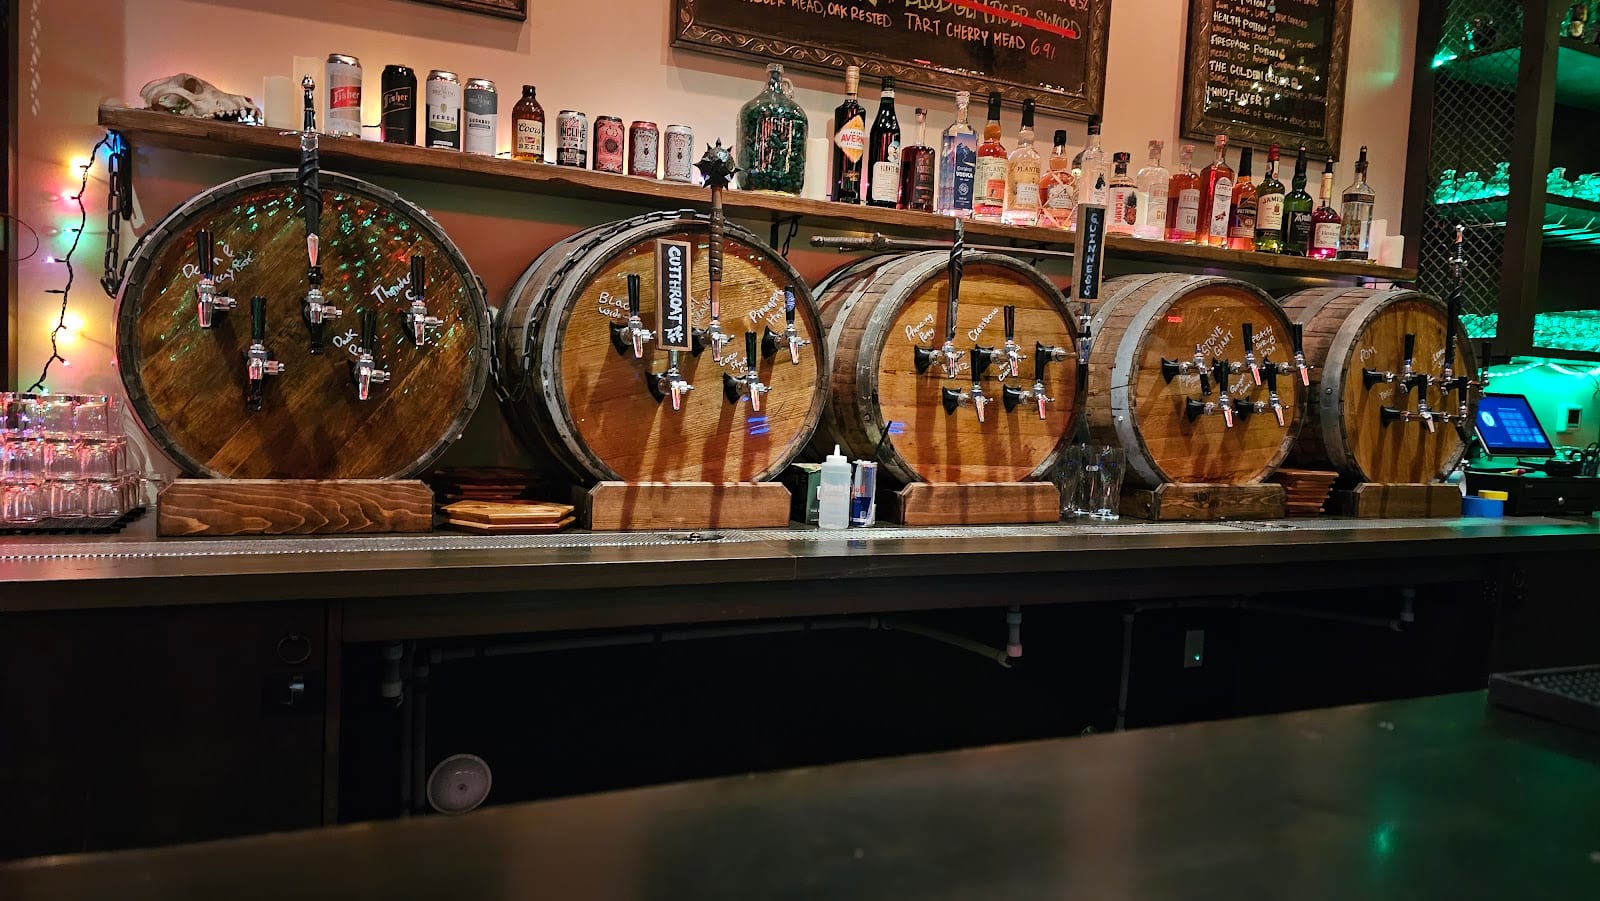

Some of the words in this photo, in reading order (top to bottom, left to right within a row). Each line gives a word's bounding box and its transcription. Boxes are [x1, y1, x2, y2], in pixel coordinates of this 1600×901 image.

[827, 2, 848, 19] OAK
[850, 6, 892, 28] RESTED
[1213, 11, 1241, 27] HEALTH
[1242, 19, 1267, 33] POTION
[904, 12, 941, 36] TART
[946, 22, 989, 47] CHERRY
[993, 31, 1026, 50] MEAD
[1210, 34, 1250, 51] FIRESPARK
[1253, 44, 1279, 58] POTION
[1209, 60, 1227, 73] THE
[1230, 64, 1264, 80] GOLDEN
[334, 88, 360, 104] Fisher
[518, 122, 541, 134] Coors
[1083, 213, 1099, 296] GUINNESS
[667, 245, 683, 325] CUTTHROAT
[919, 327, 935, 342] Pony
[1202, 325, 1224, 356] STONE
[1214, 329, 1234, 357] GIANT
